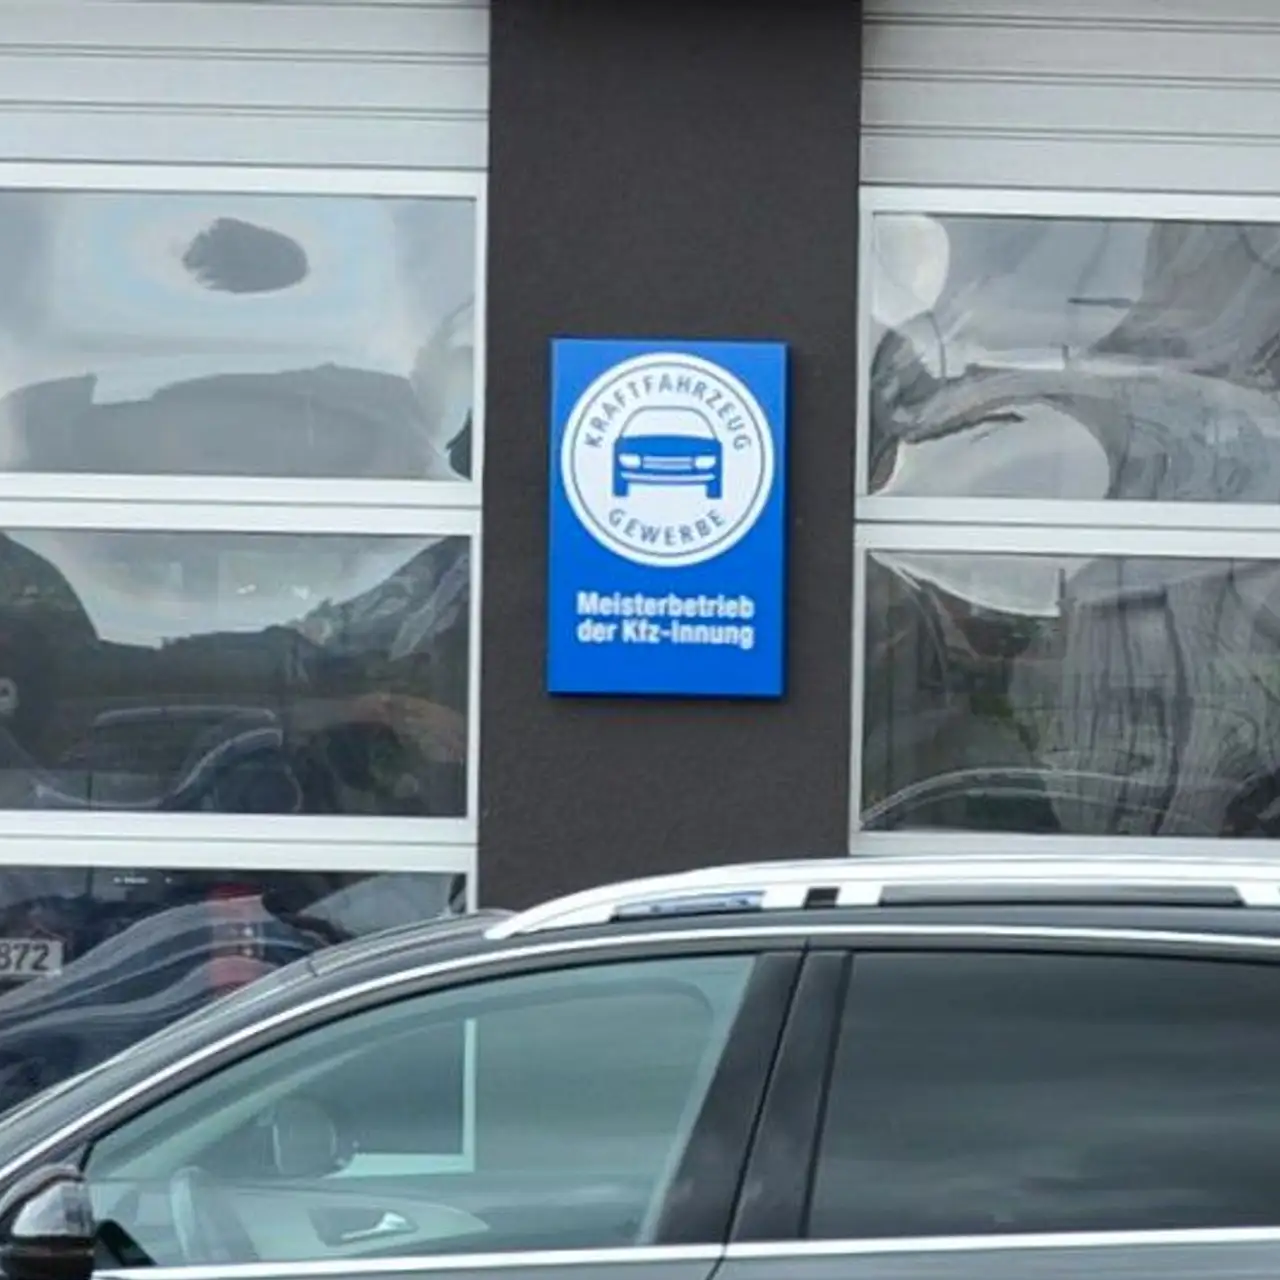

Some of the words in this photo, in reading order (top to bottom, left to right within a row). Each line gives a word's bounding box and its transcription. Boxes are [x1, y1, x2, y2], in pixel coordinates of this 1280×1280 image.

[584, 373, 752, 451] KRAFTFAHRZEUG
[608, 508, 726, 547] GEWERBE
[576, 591, 755, 619] Meisterbetrieb
[577, 619, 617, 643] der
[622, 619, 755, 649] Kfz-Innung
